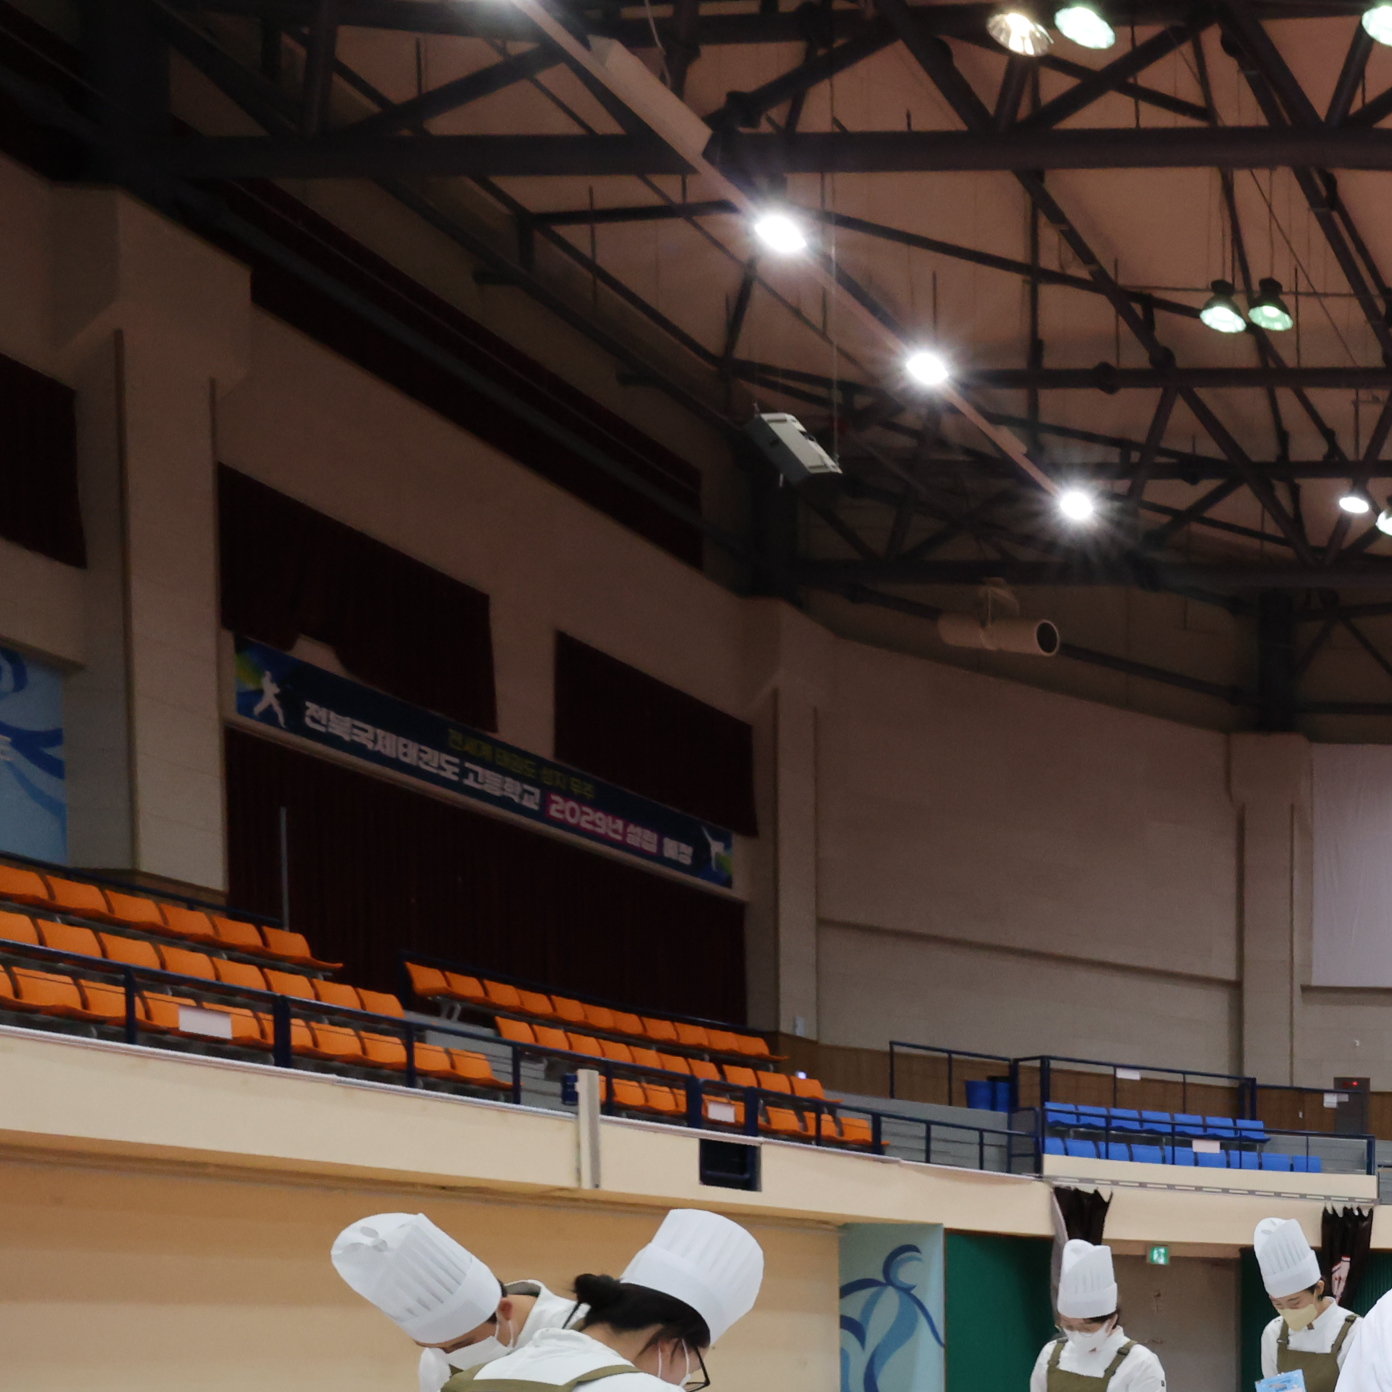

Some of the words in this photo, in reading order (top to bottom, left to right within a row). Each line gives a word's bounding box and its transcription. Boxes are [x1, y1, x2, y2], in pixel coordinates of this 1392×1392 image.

[305, 700, 460, 781] 전북국제태권도
[463, 761, 541, 811] 고등학교
[549, 794, 624, 841] 2029년
[626, 823, 659, 853] 설립
